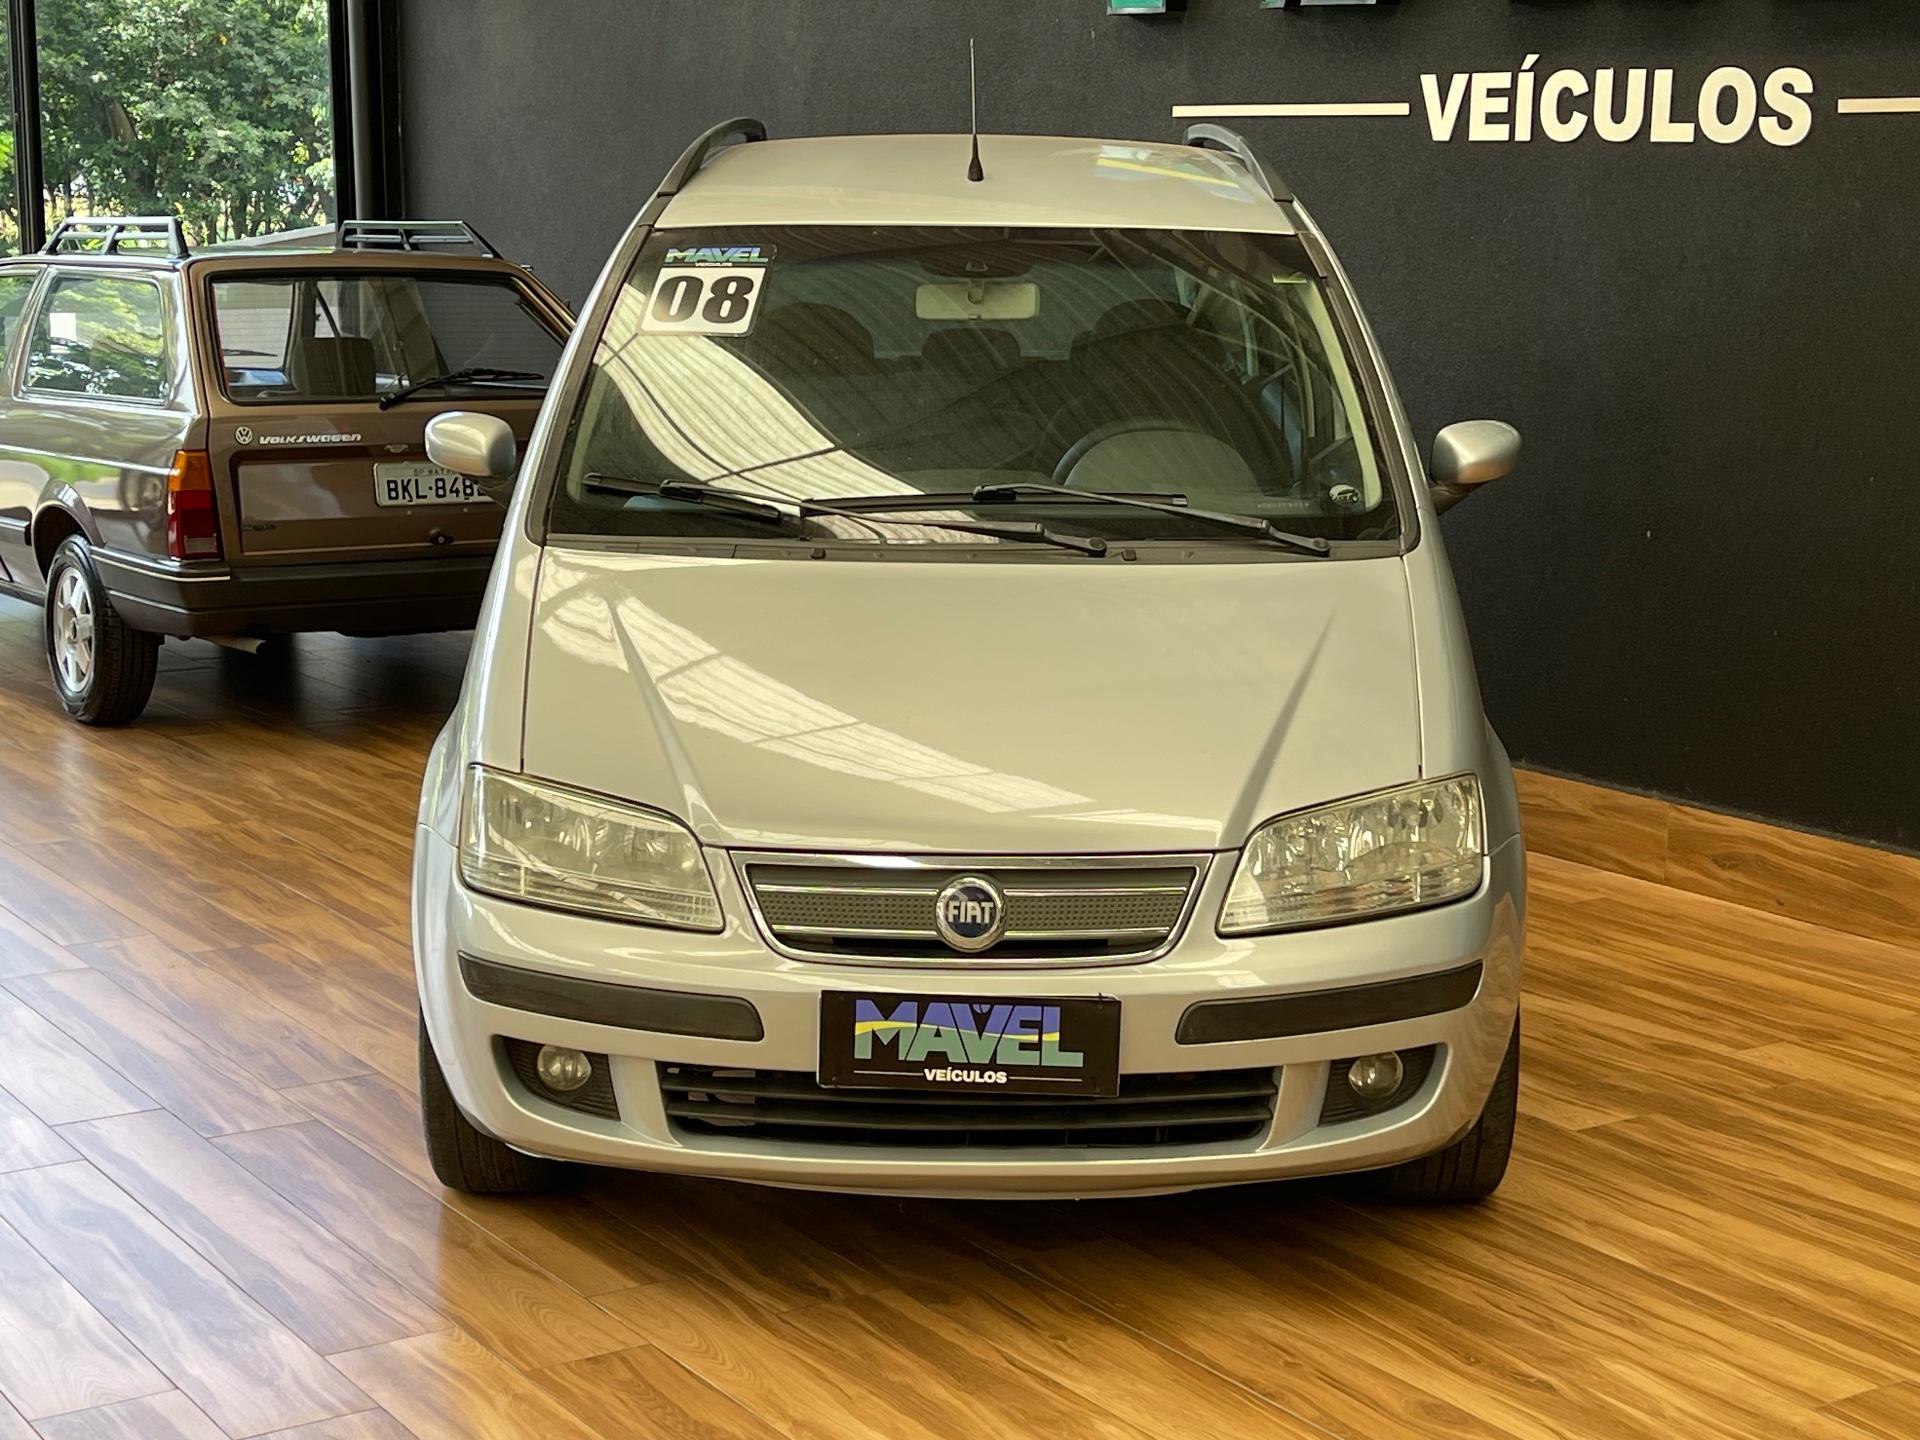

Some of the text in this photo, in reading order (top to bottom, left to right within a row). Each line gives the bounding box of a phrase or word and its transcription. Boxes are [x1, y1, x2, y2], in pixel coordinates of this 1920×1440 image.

[1420, 54, 1814, 146] VEÍCULOS
[664, 247, 769, 263] MAVEL
[651, 275, 754, 324] 08
[947, 900, 994, 924] FIAT
[854, 999, 1084, 1067] MAVEL
[923, 1067, 1008, 1084] VEÍCULOS
